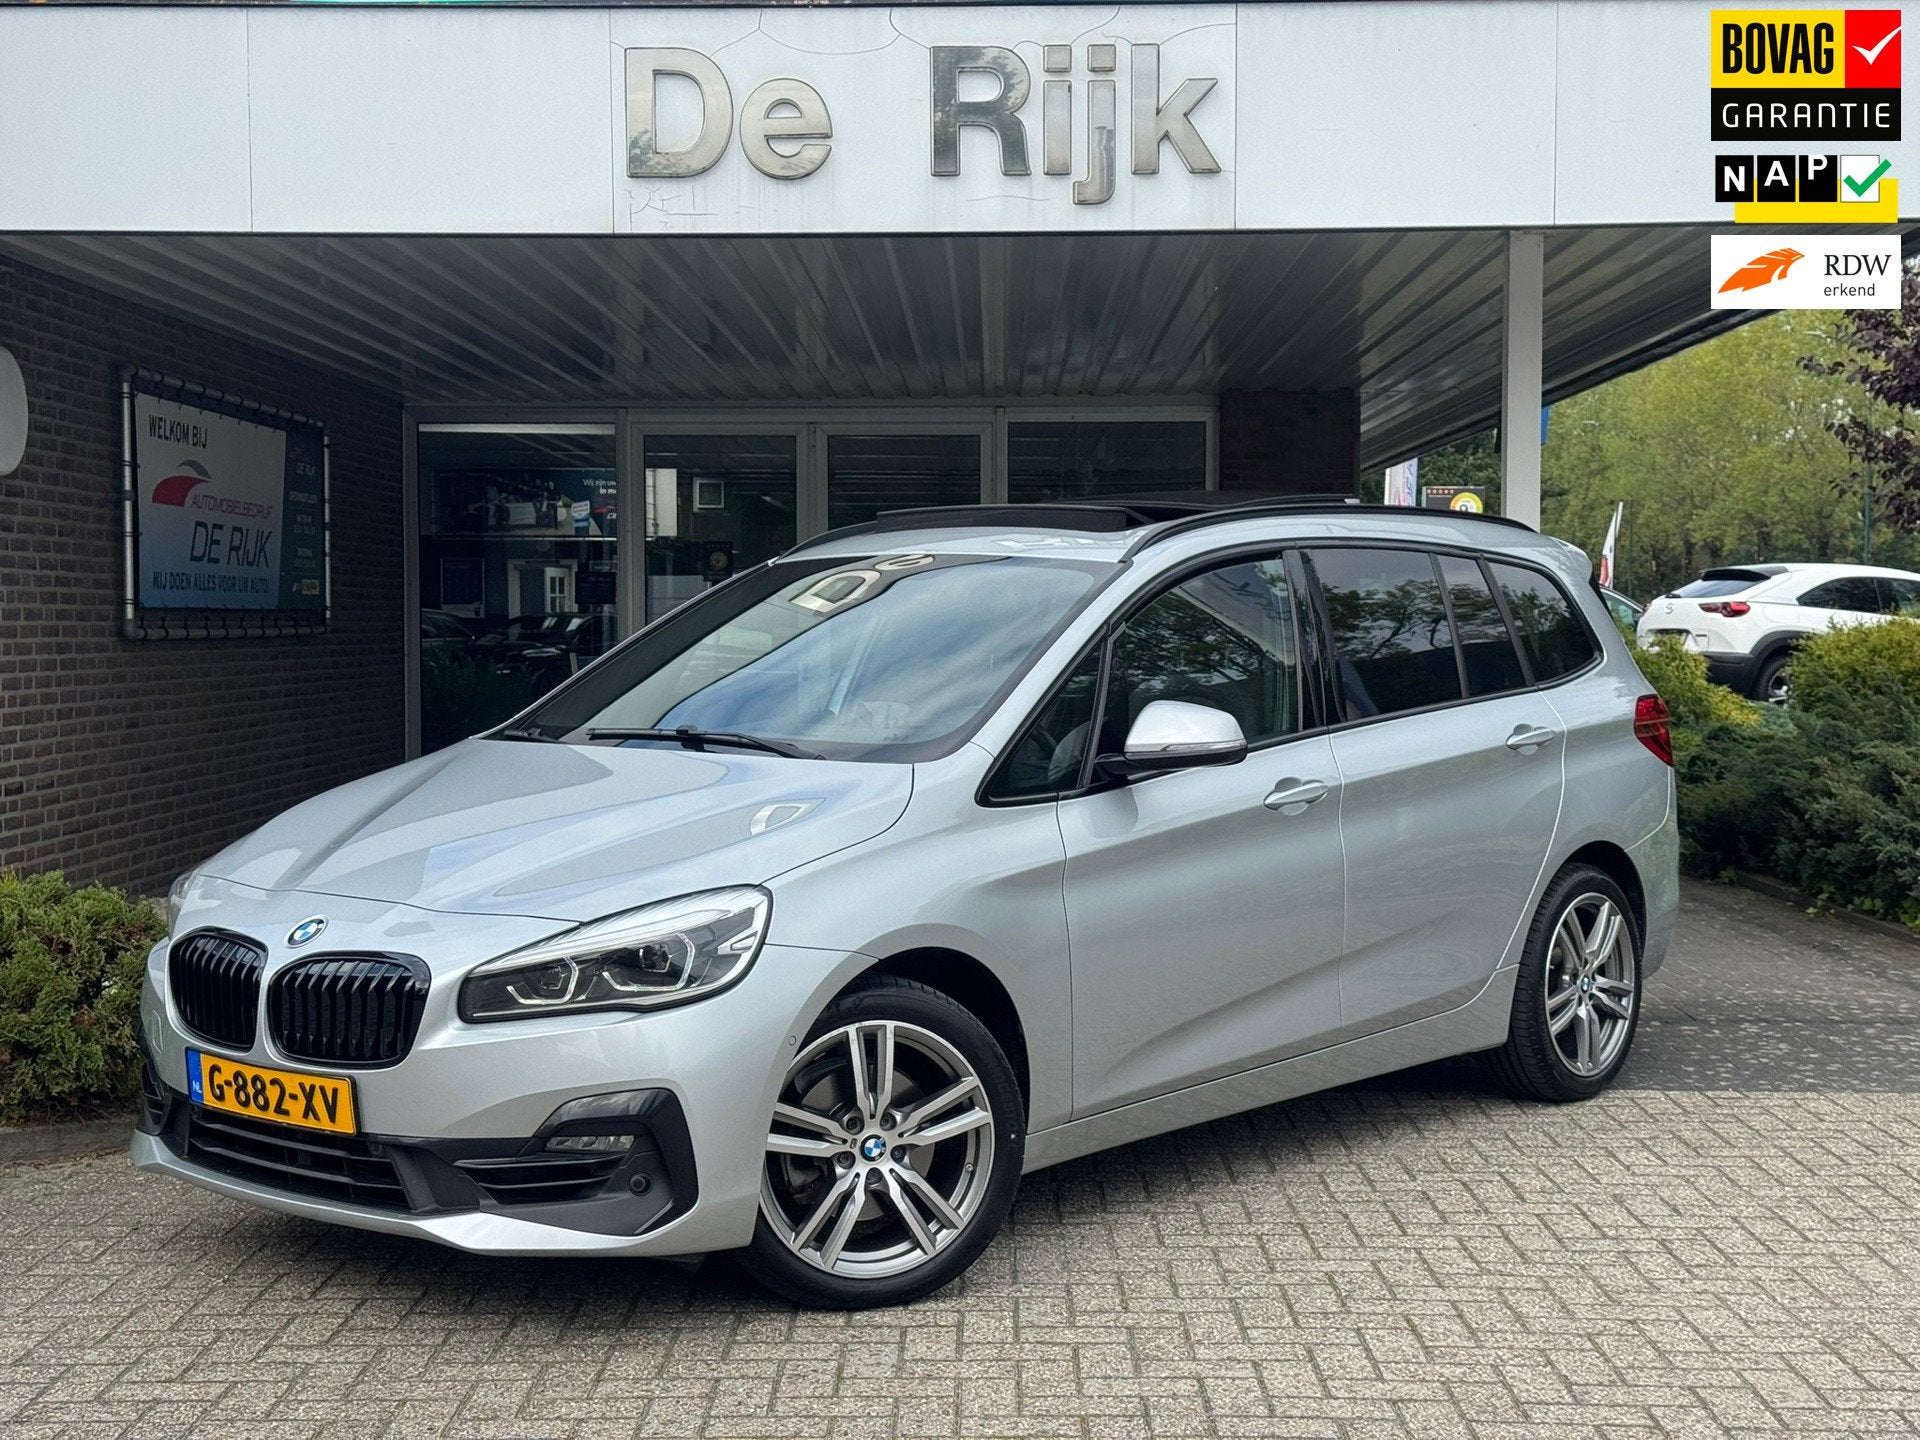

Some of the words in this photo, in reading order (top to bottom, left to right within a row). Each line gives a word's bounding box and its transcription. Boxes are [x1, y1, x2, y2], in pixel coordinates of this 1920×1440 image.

[624, 47, 833, 180] De
[929, 43, 1222, 205] Rijk
[149, 414, 189, 446] WELKOM
[192, 426, 208, 449] BIJ
[191, 494, 273, 520] AUTOMOBIELBEDRIJF
[190, 521, 224, 564] DE
[227, 526, 273, 569] RIJK
[153, 571, 167, 590] WIJ
[169, 571, 191, 591] DOEN
[194, 573, 217, 592] ALLES
[217, 574, 236, 592] VOOR
[238, 576, 249, 593] UW
[192, 1080, 202, 1094] NL
[208, 1063, 339, 1124] G-882-XV
